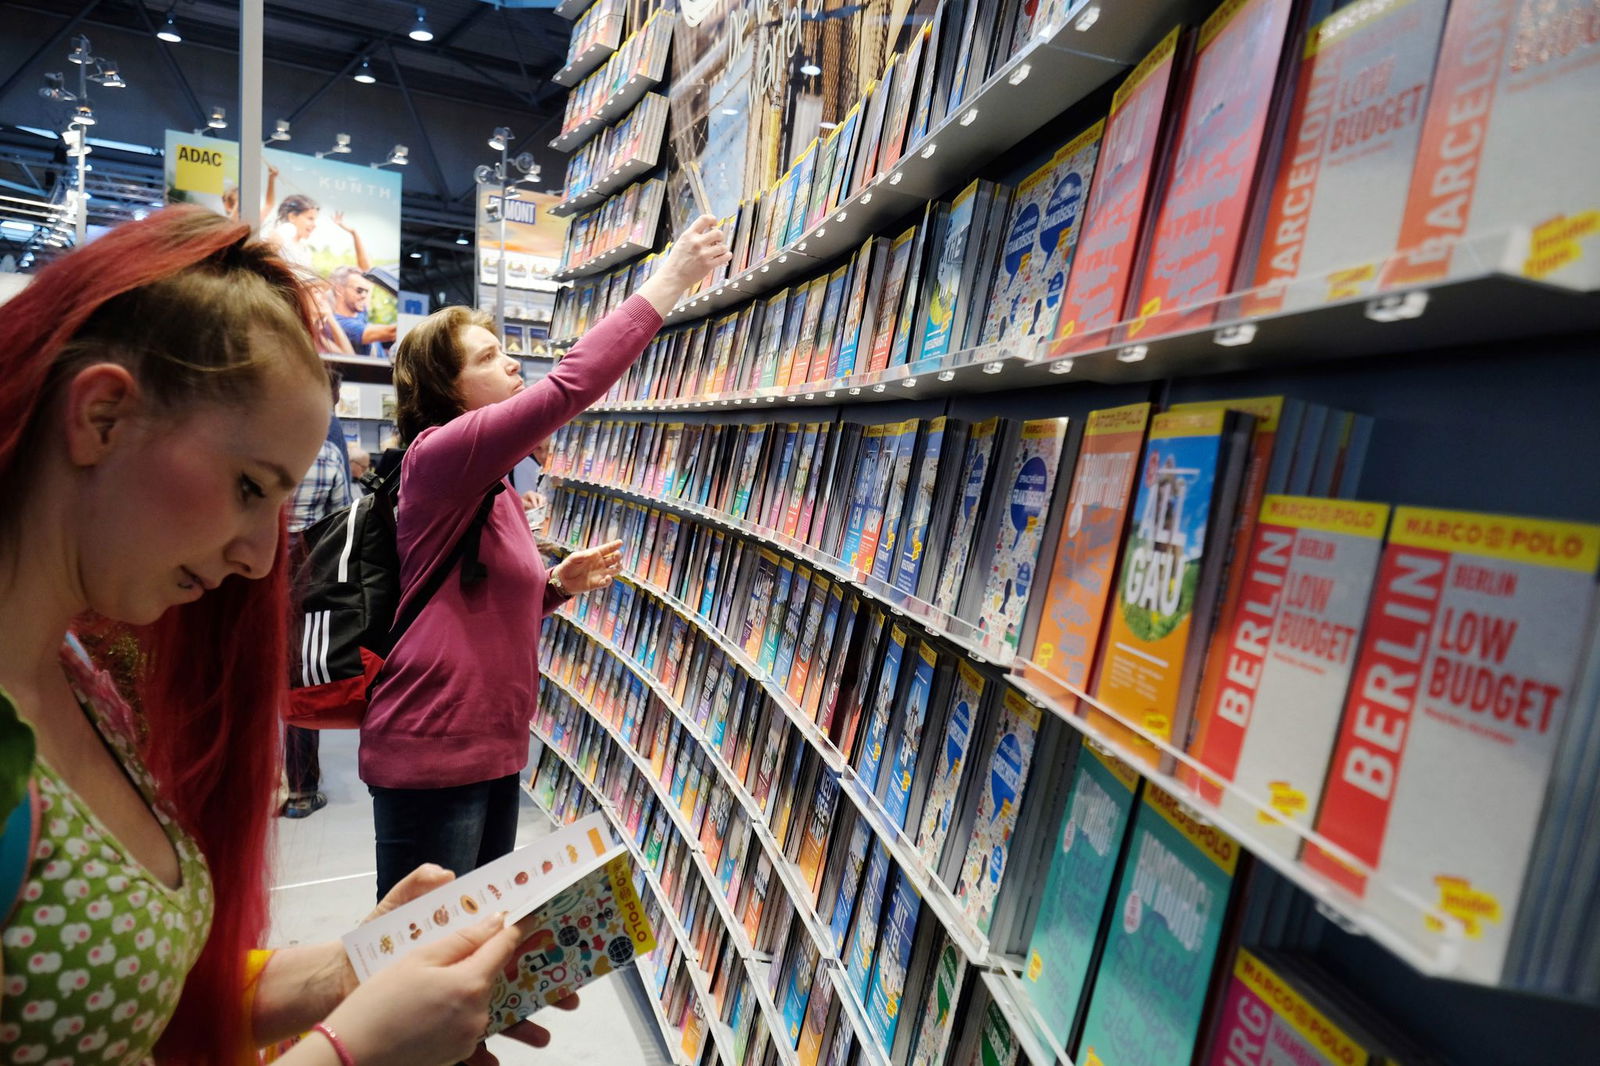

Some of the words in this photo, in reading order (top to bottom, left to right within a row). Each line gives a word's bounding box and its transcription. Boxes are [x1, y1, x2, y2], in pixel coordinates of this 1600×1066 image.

[1330, 83, 1425, 152] BUDGET
[178, 146, 222, 168] ADAC
[319, 176, 392, 199] KUNTH
[1270, 502, 1318, 523] MARCO
[1334, 508, 1376, 529] POLO
[1406, 517, 1482, 545] MARCO
[1510, 529, 1584, 559] POLO
[1286, 571, 1334, 614] LOW
[1453, 564, 1519, 597] BERLIN
[1217, 531, 1292, 729] BERLIN
[1276, 610, 1357, 665] BUDGET
[1439, 605, 1519, 664] LOW
[1344, 553, 1443, 801] BERLIN
[1428, 655, 1563, 734] BUDGET
[625, 901, 647, 942] POLO
[1243, 960, 1294, 1013] MARCO
[1310, 1019, 1354, 1065] POLO
